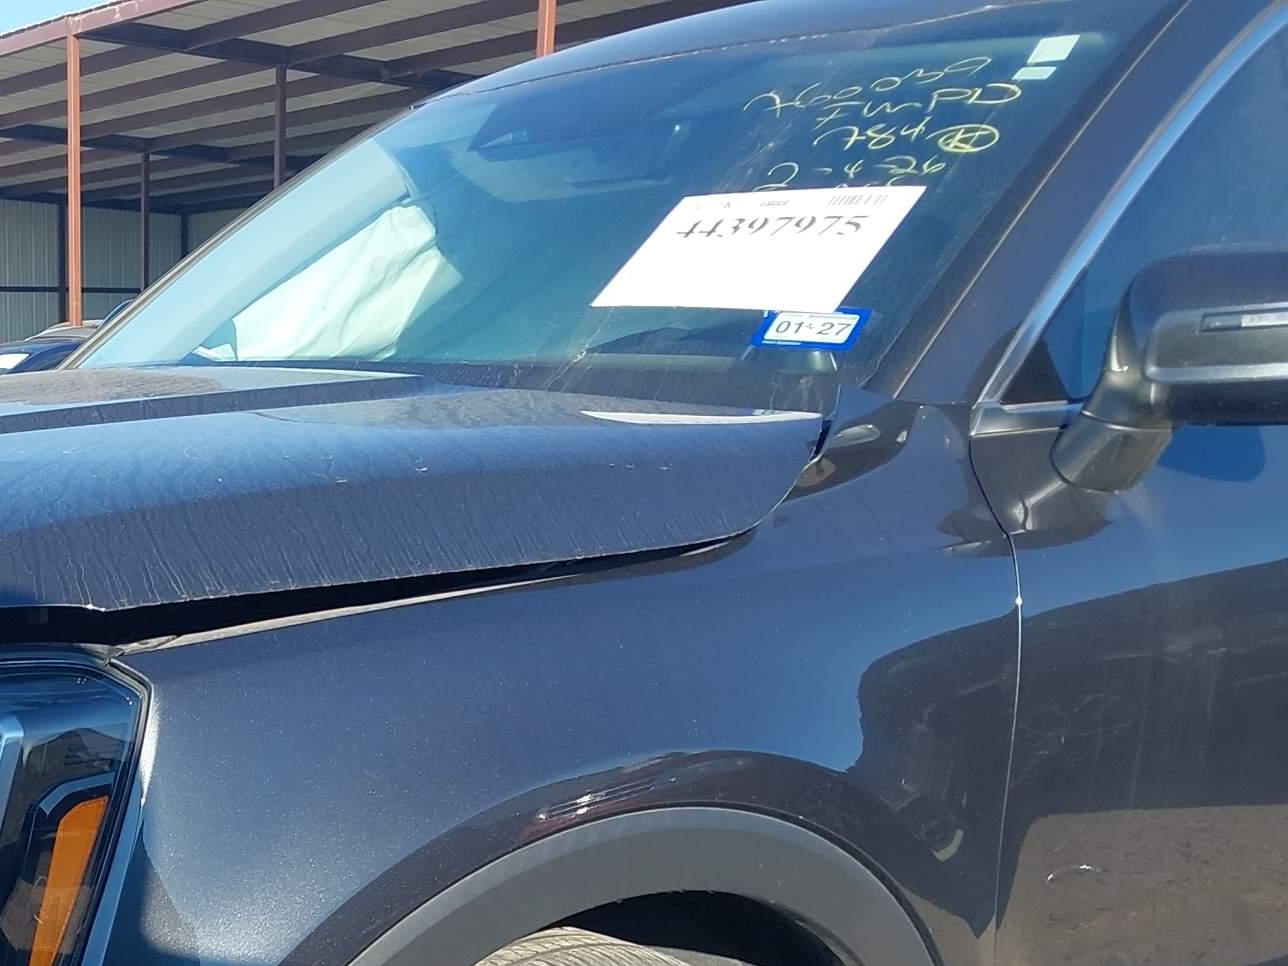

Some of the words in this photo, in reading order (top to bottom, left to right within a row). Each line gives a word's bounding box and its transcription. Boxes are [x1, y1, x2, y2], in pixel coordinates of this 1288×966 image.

[676, 215, 868, 238] 44397975
[775, 320, 804, 334] 01
[816, 322, 852, 336] 27
